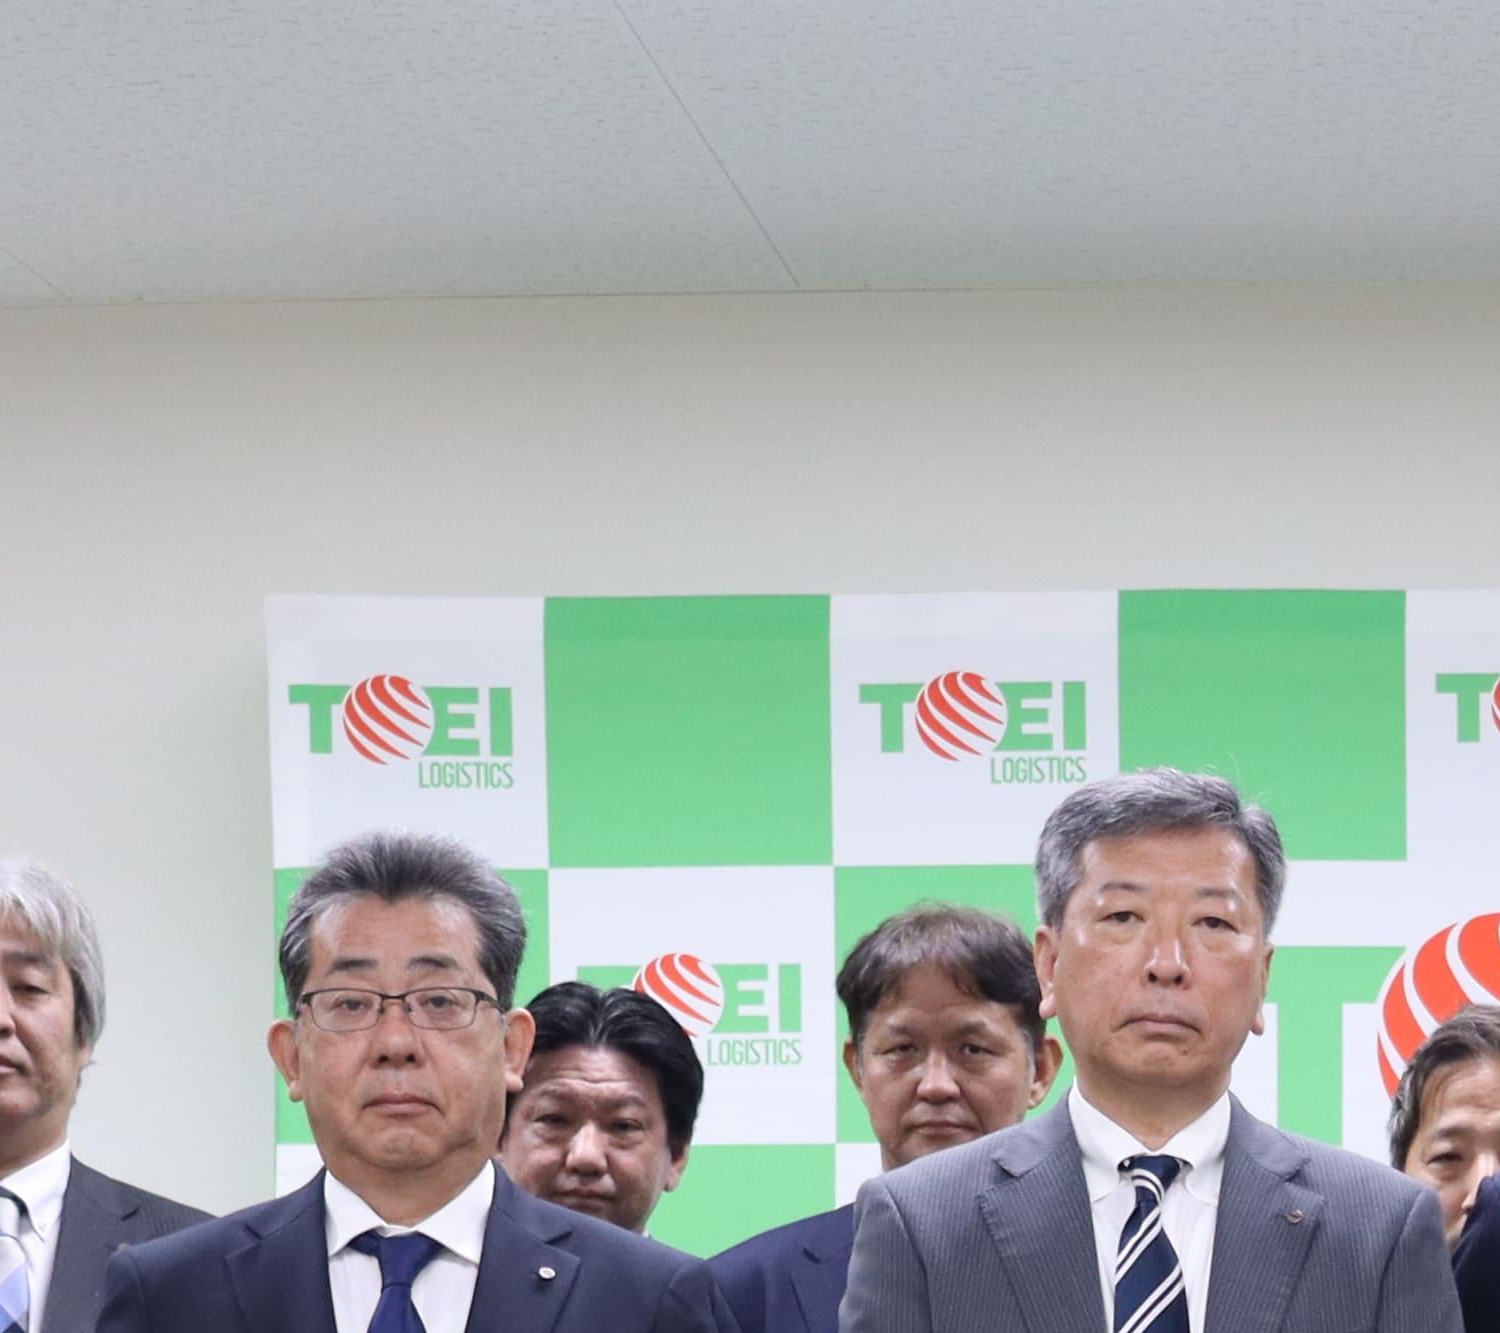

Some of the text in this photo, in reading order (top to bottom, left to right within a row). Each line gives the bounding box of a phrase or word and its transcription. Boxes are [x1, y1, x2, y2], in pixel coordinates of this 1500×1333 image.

[289, 675, 514, 765] TOEI
[859, 671, 1088, 761] TOEI
[419, 761, 514, 789] LOGISTICS
[991, 757, 1086, 784] LOGISTICS
[707, 1038, 802, 1066] LOGISTICS
